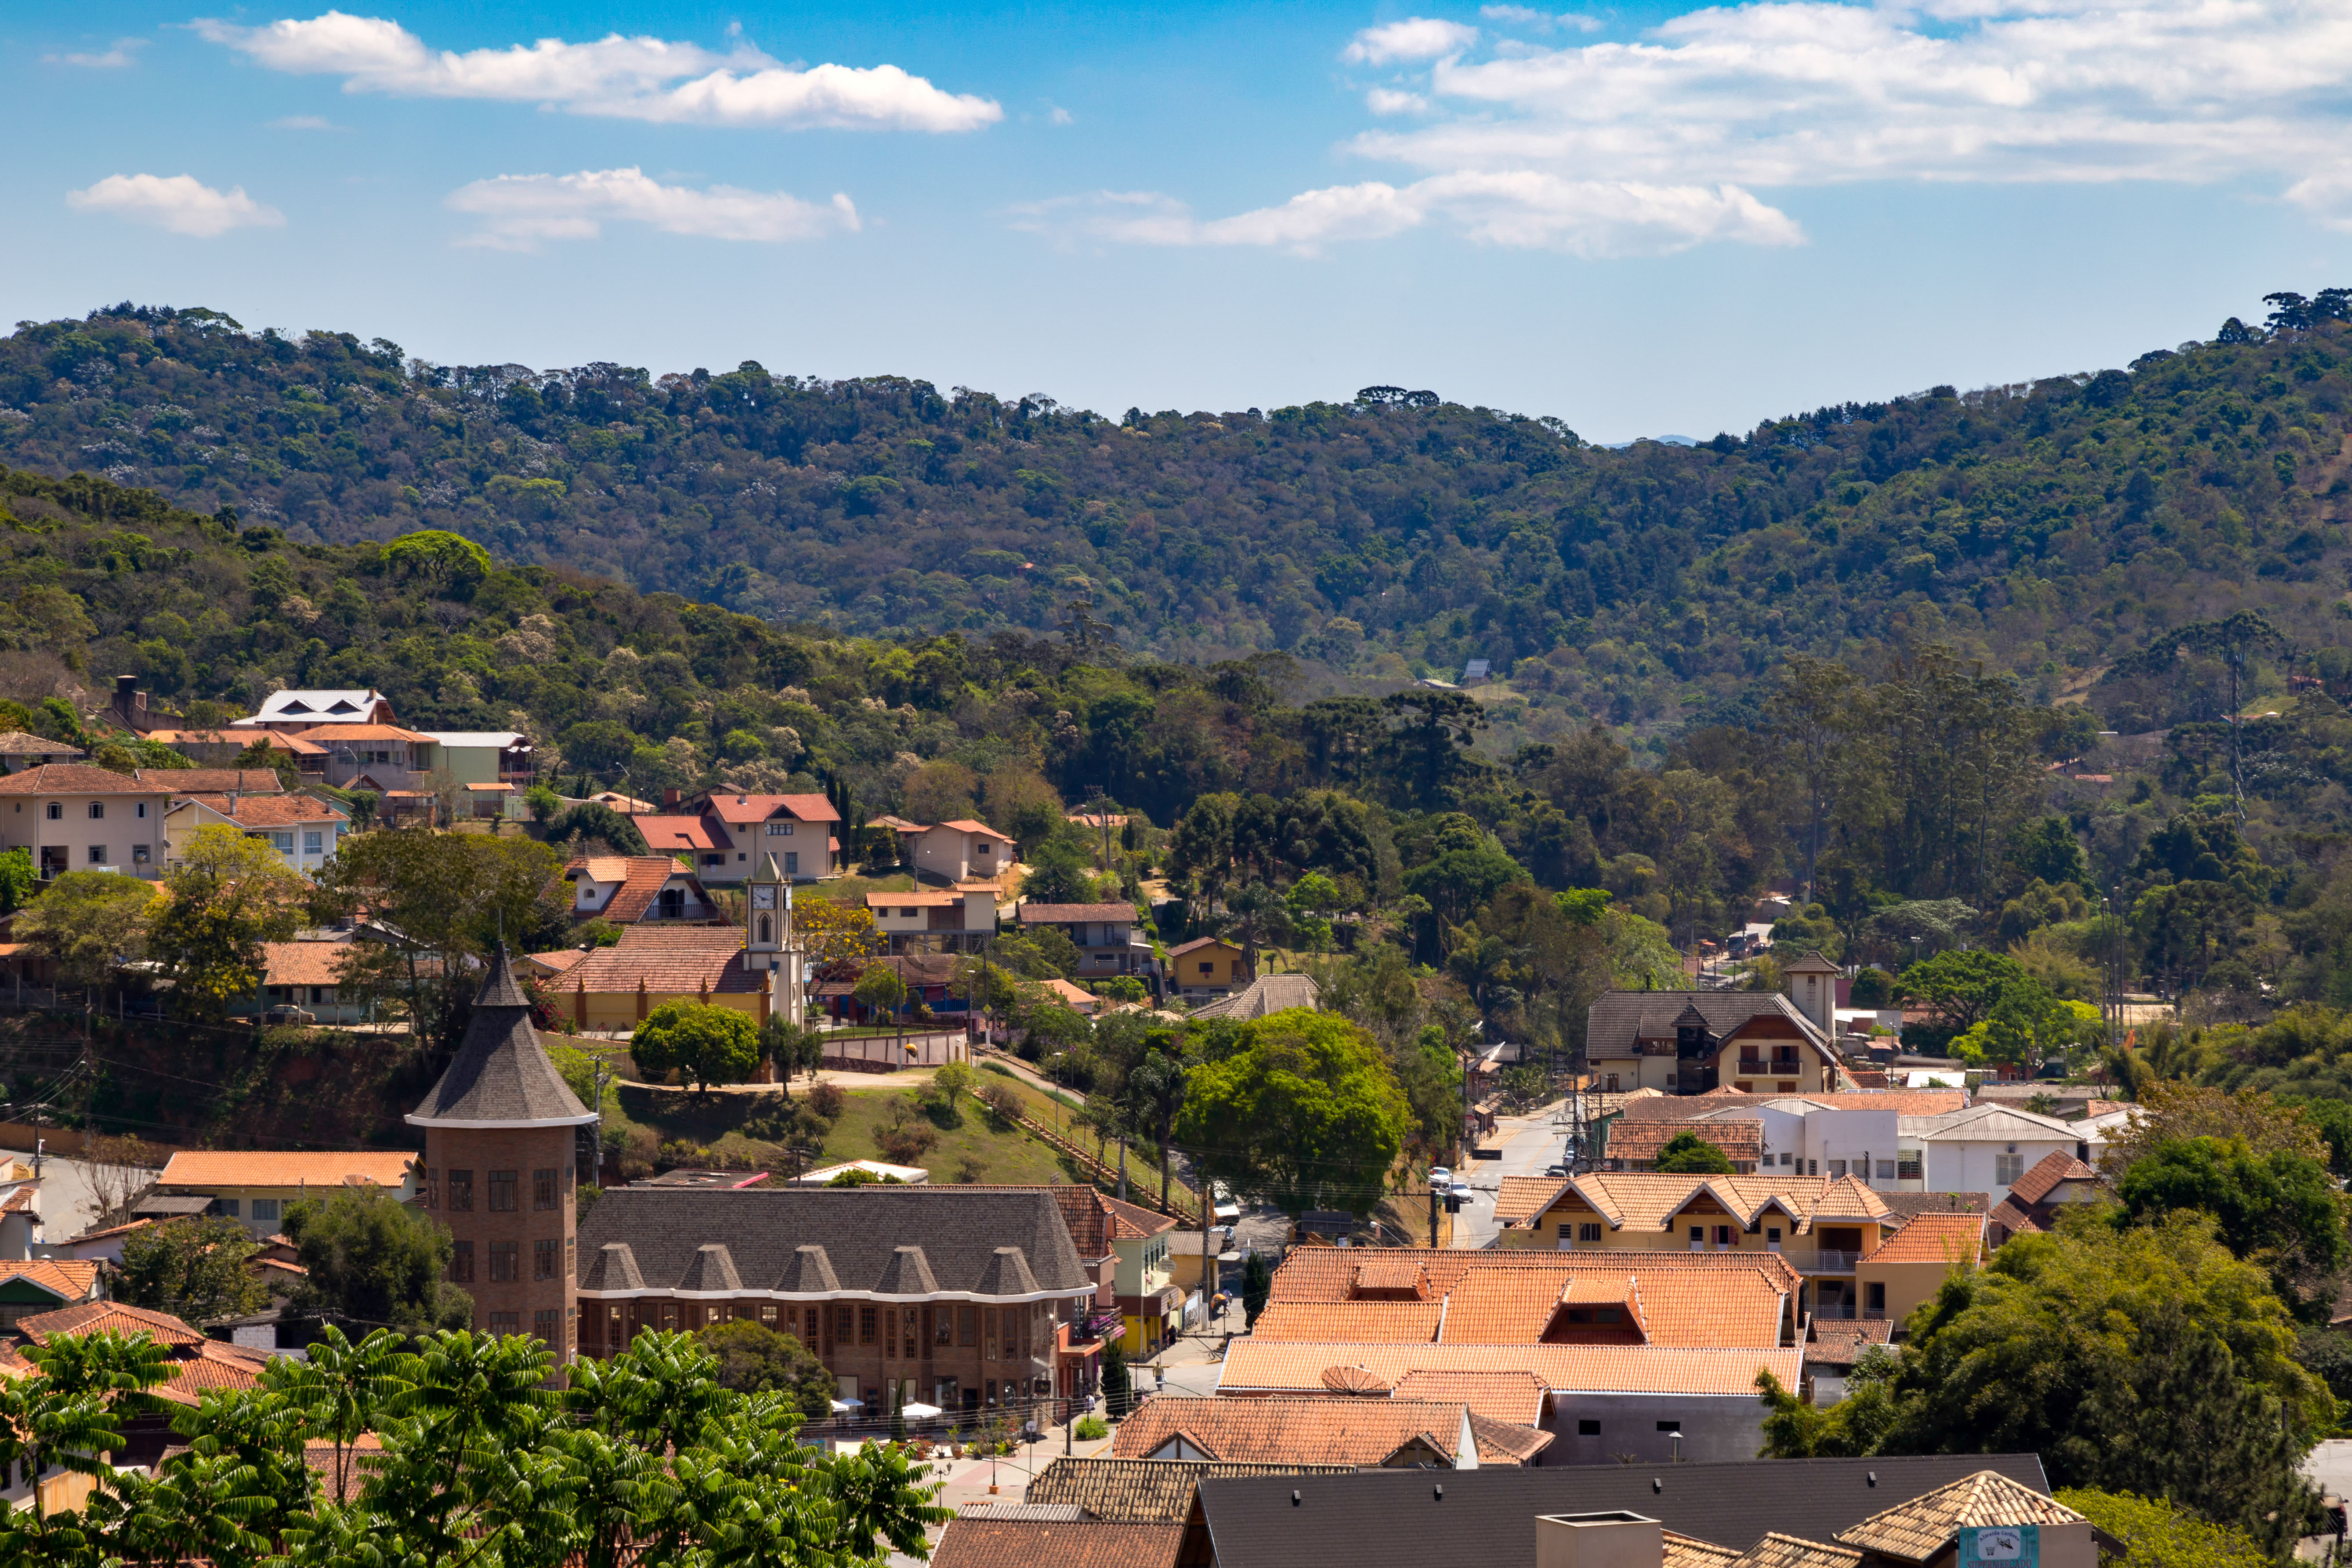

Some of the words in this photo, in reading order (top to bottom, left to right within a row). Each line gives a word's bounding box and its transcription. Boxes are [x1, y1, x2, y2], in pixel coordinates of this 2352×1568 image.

[1979, 1531, 2000, 1542] Almeida
[2001, 1531, 2020, 1542] Cardoso
[1967, 1558, 2032, 1568] SUPERMERCADO
